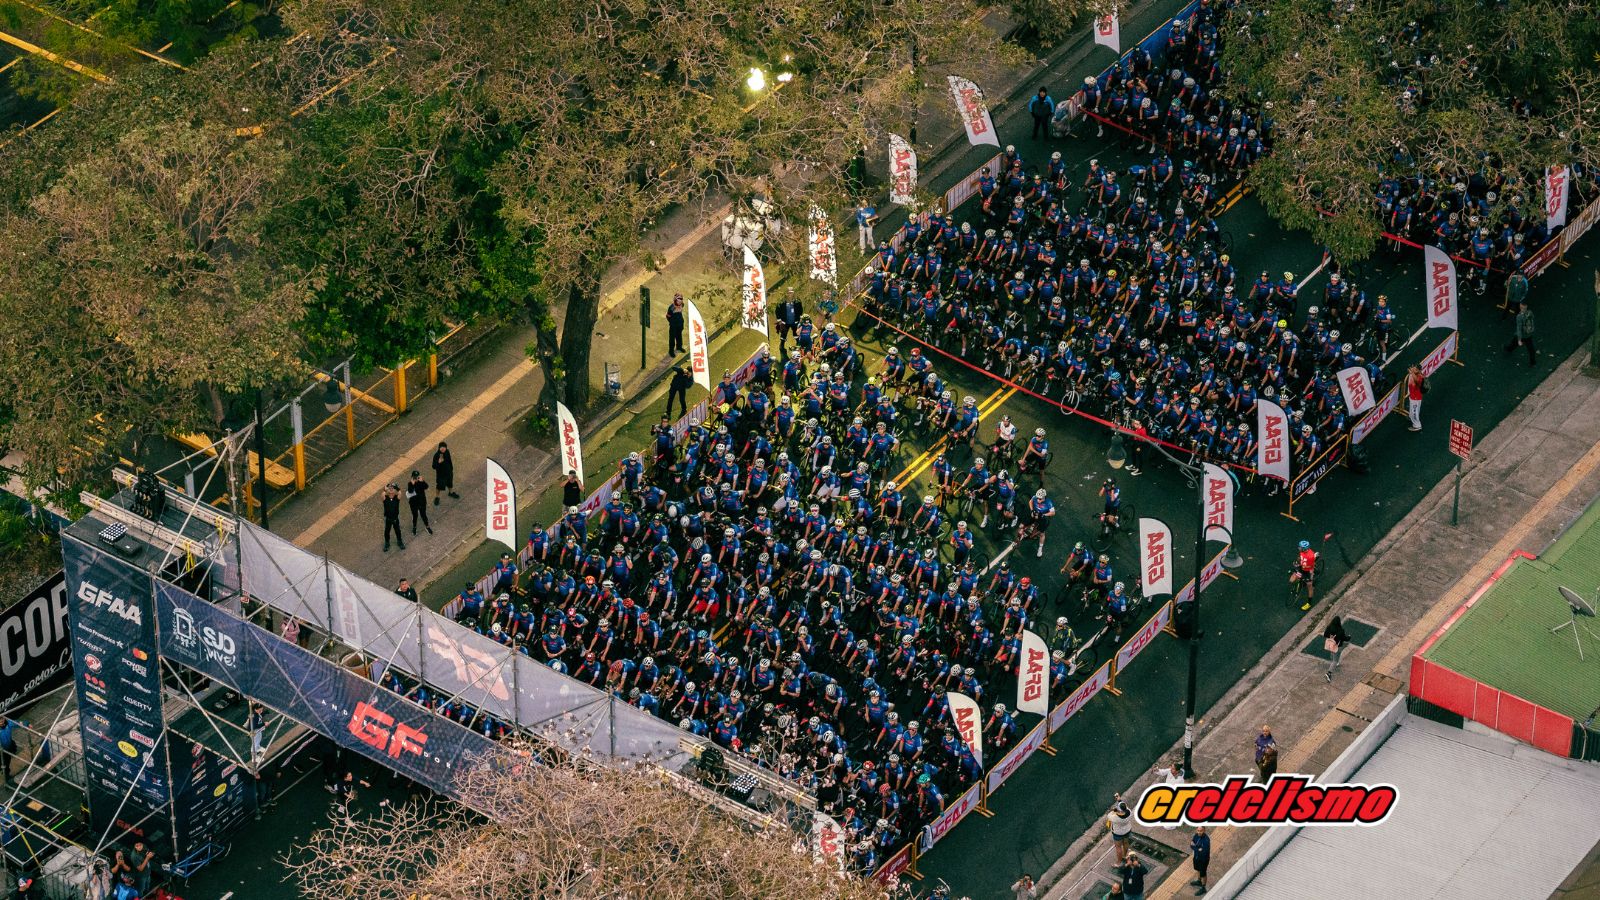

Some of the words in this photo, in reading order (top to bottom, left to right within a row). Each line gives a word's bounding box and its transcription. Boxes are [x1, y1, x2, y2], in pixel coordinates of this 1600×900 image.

[77, 580, 142, 626] GFAA
[203, 626, 236, 656] SJD
[347, 700, 430, 760] GF
